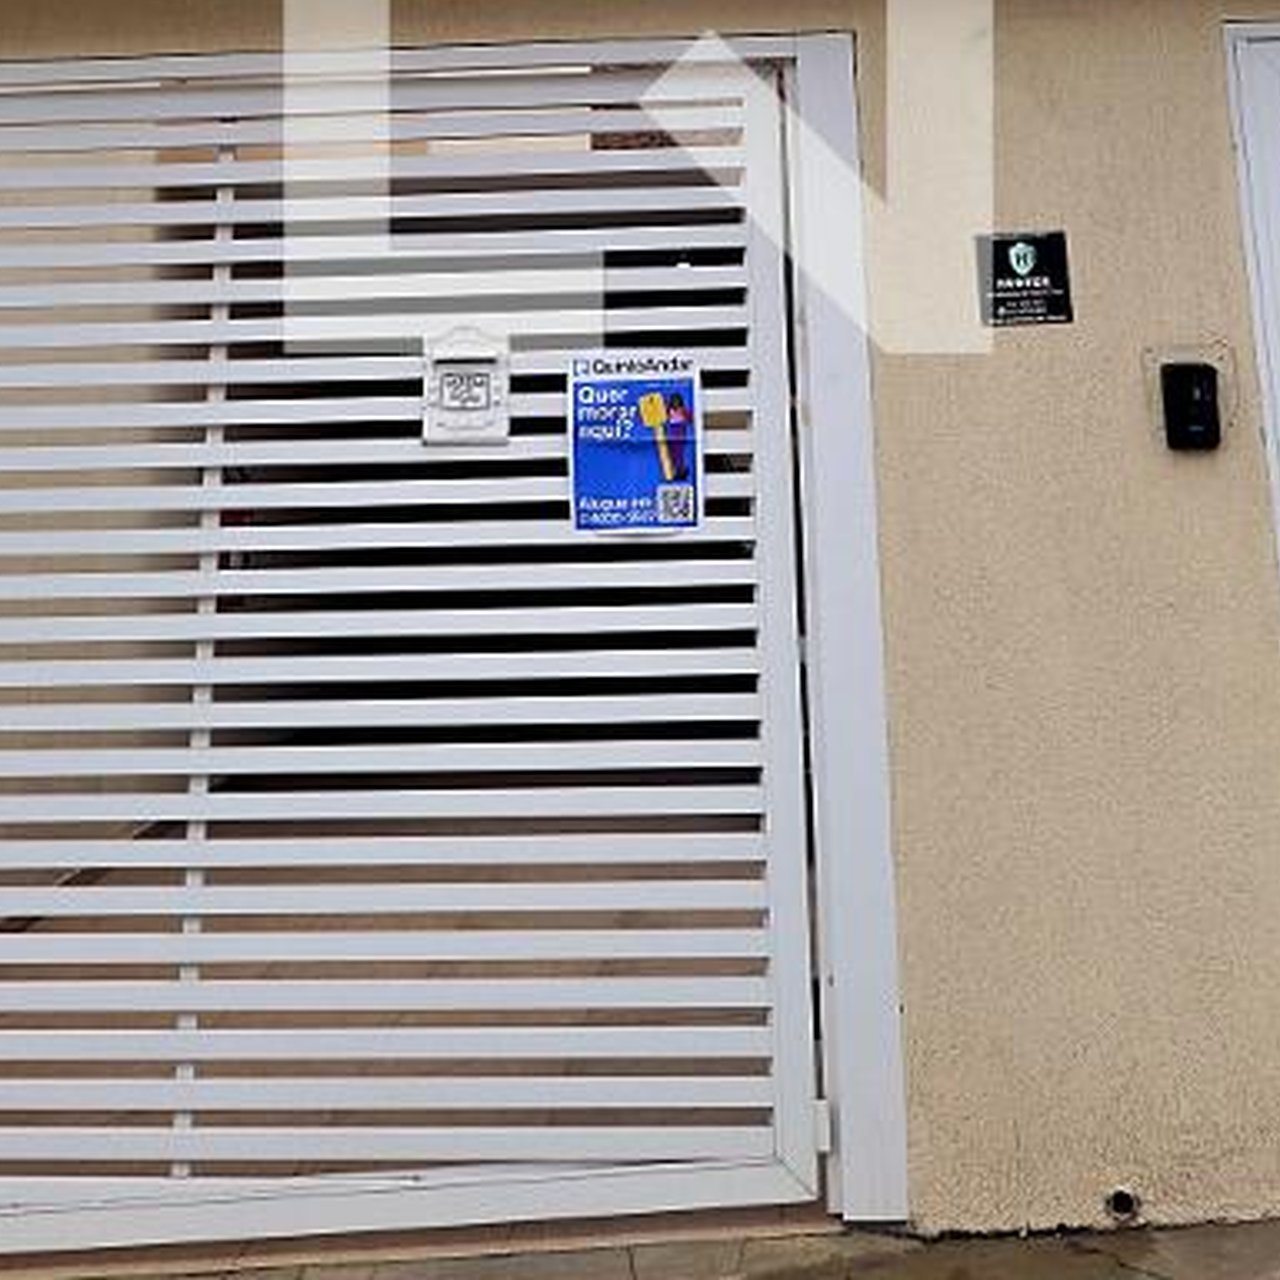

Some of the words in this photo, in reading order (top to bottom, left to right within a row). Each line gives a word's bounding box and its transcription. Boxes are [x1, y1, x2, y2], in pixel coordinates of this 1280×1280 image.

[577, 384, 629, 404] Quer
[578, 405, 637, 422] morar
[578, 420, 634, 439] aqui?
